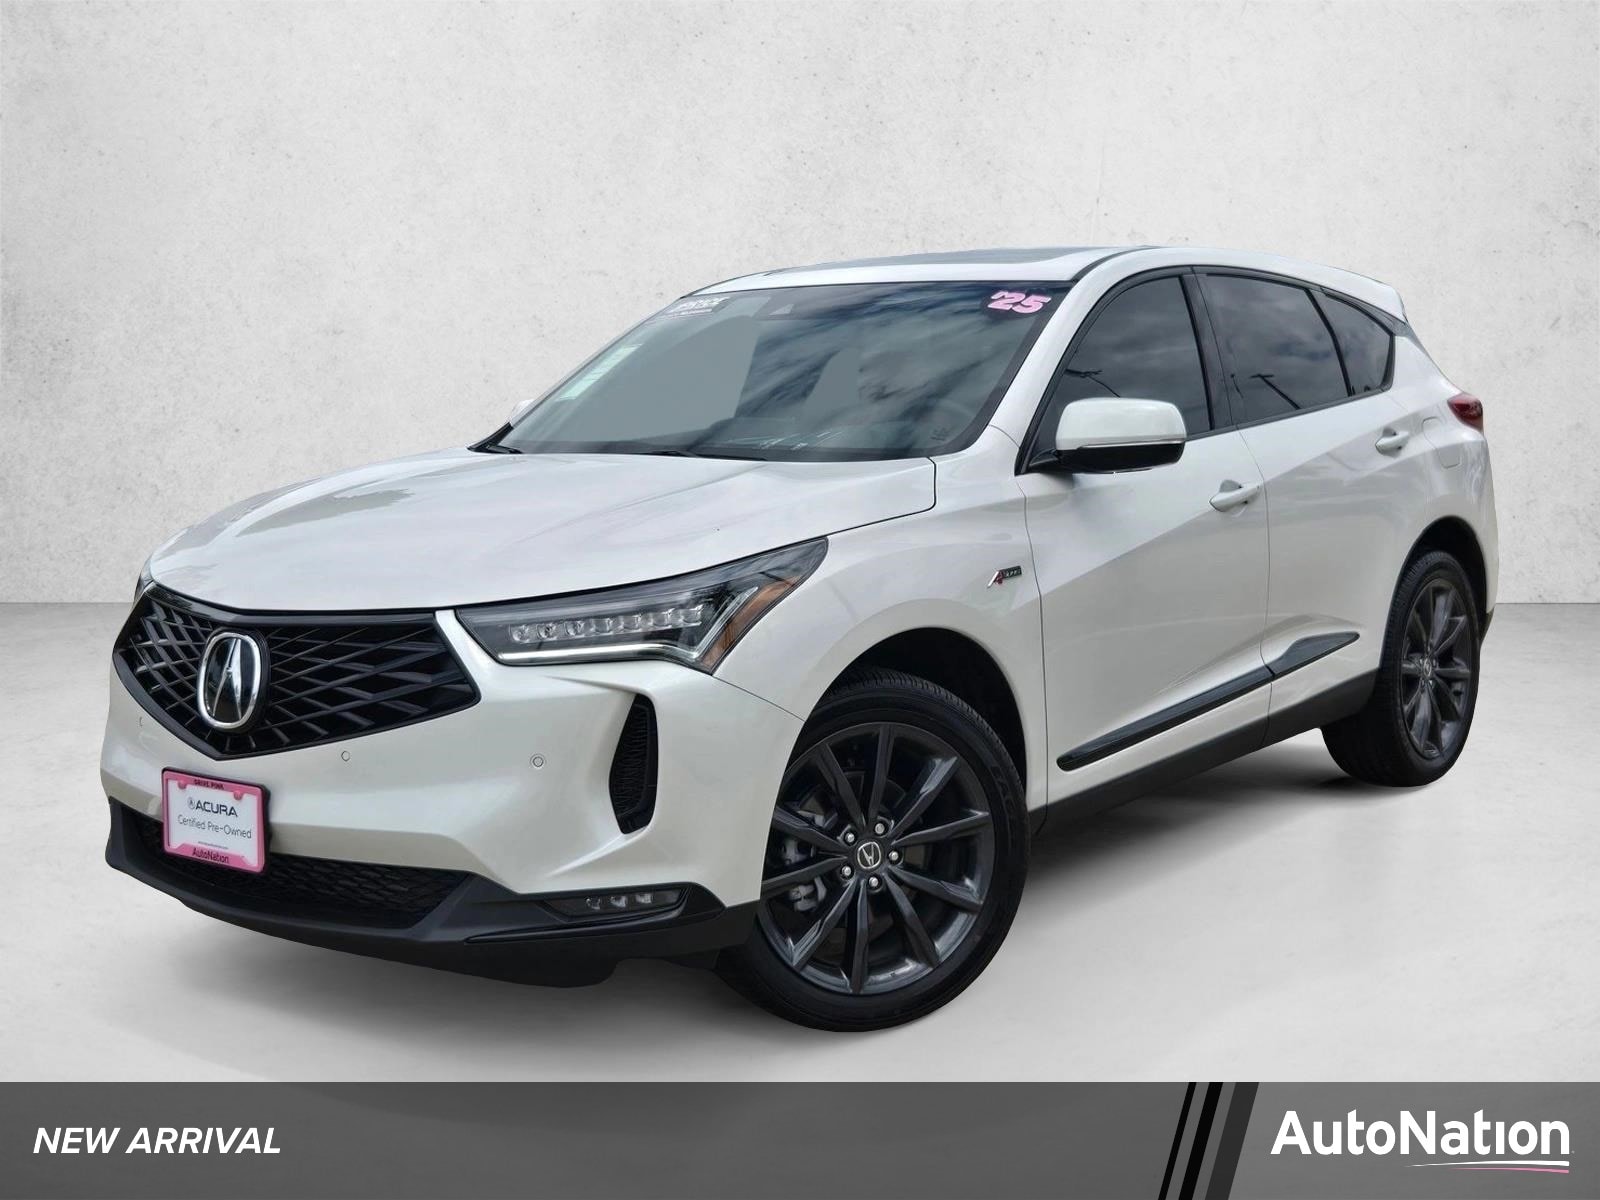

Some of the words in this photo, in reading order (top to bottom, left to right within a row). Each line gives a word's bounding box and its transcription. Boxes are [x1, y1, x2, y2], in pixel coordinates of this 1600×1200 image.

[195, 800, 238, 817] ACURA
[177, 814, 206, 830] Certified
[207, 821, 252, 838] Pre-Owned
[192, 847, 229, 864] AutoNation
